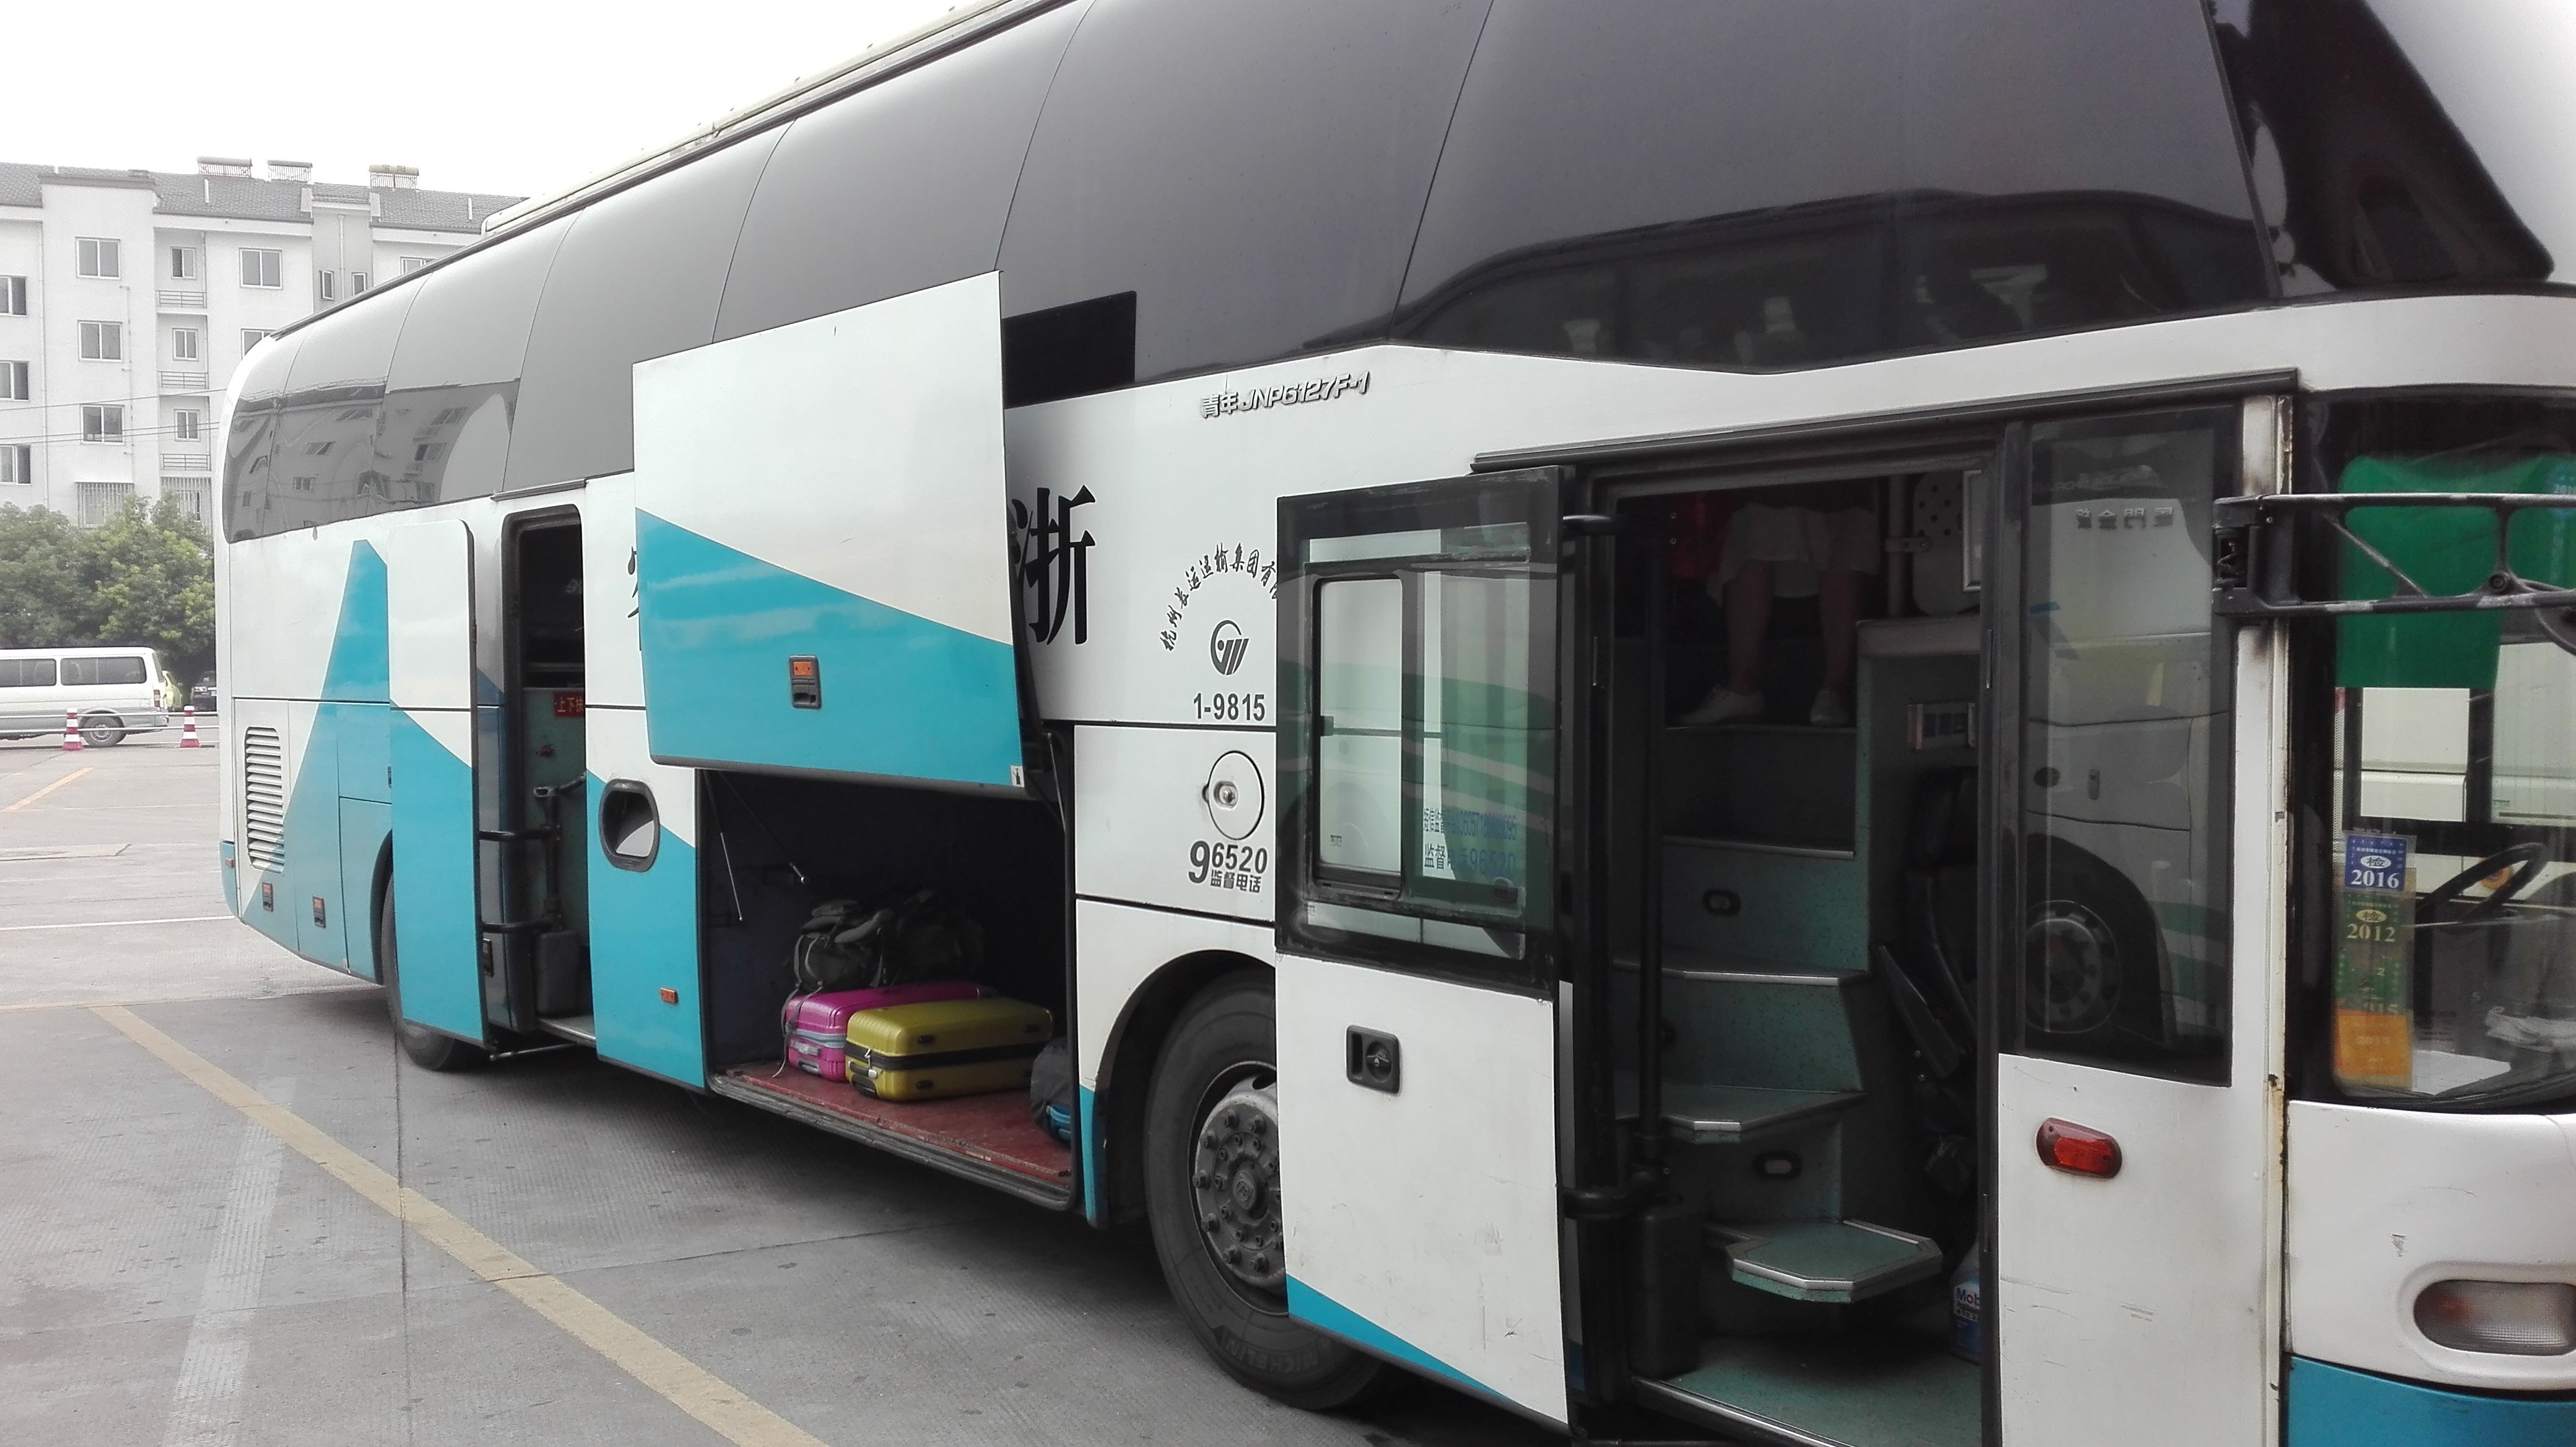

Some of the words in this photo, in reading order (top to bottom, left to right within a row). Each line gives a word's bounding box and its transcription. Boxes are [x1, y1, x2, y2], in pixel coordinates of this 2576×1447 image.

[1201, 391, 1238, 419] 青年
[1239, 372, 1370, 411] JNP6127F-1
[1011, 484, 1095, 645] 浙
[1193, 693, 1265, 721] 1-9815
[1188, 840, 1268, 884] 96520
[2366, 857, 2386, 867] 检
[1211, 869, 1262, 893] 监督电话
[2351, 869, 2400, 888] 2016
[2347, 923, 2396, 942] 2012
